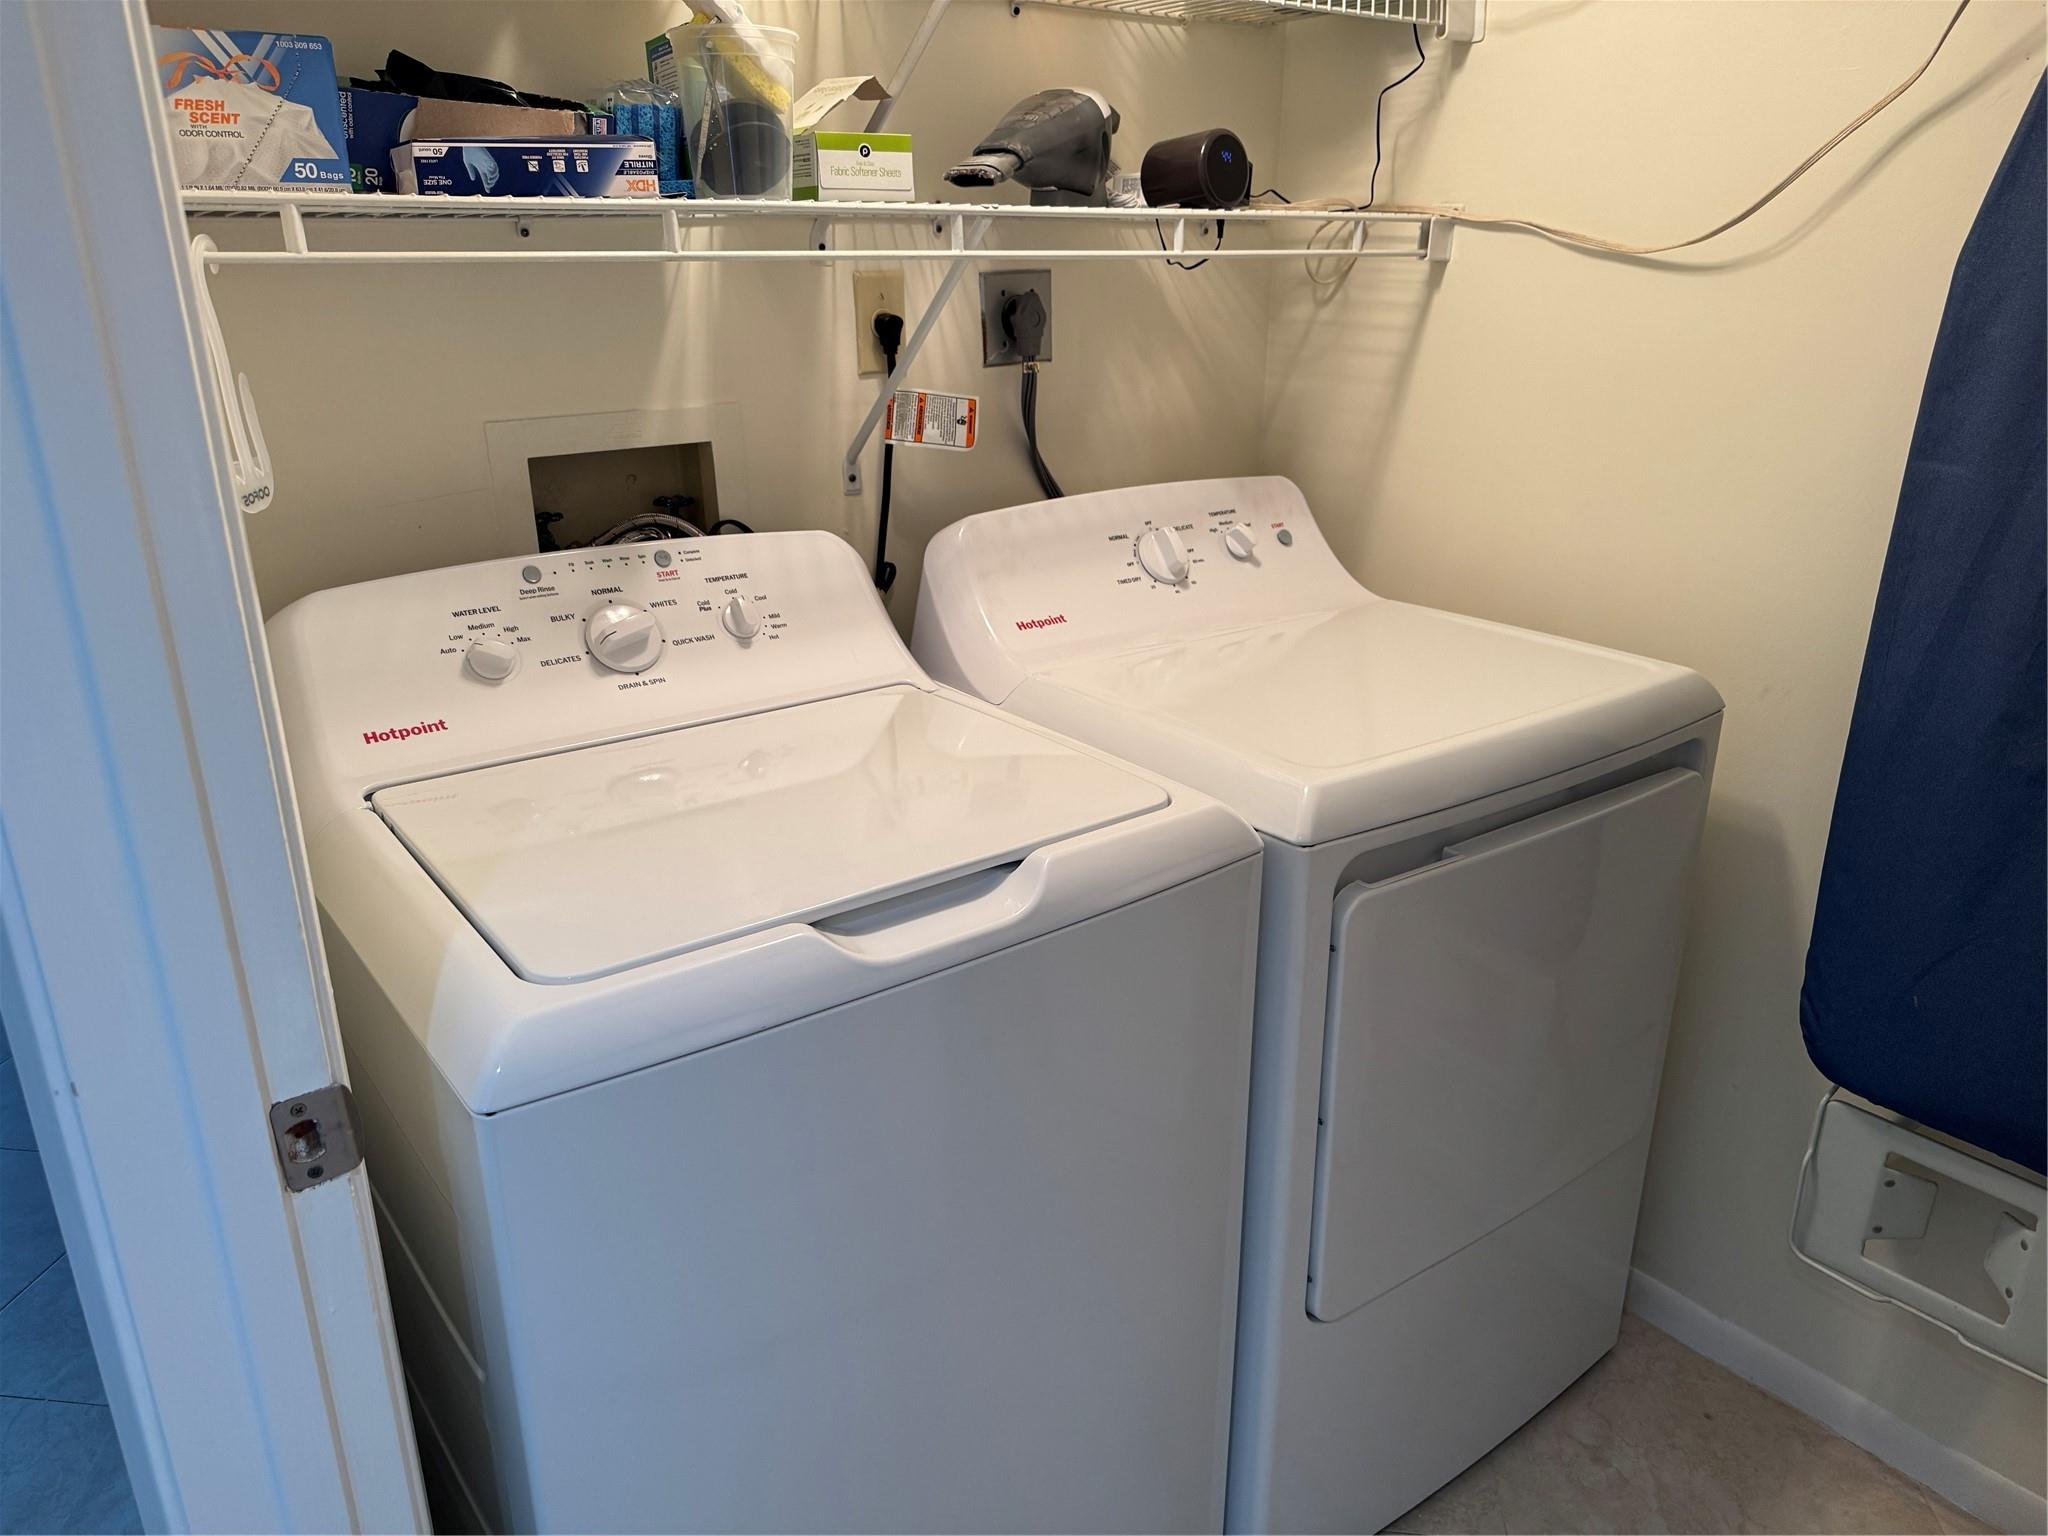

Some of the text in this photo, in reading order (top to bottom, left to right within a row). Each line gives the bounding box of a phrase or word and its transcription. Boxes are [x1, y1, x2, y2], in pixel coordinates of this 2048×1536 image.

[174, 99, 225, 111] FRESH
[189, 112, 240, 125] SCENT
[179, 129, 244, 139] ODOR CONTROL
[294, 162, 317, 179] 50
[320, 171, 344, 180] Bags
[364, 168, 379, 185] 20
[830, 166, 902, 178] Fabric Softener Sheets
[627, 180, 657, 192] HDX
[656, 570, 679, 578] START
[704, 573, 748, 583] TEMPERATURE
[520, 588, 537, 596] Deep
[591, 586, 623, 596] NORMAL
[650, 599, 678, 609] WHITES
[452, 606, 501, 618] WATER LEVEL
[550, 613, 576, 623] BULKY
[468, 622, 495, 631] Medium
[1016, 614, 1067, 631] Hotpoint
[503, 625, 519, 633] High
[672, 634, 715, 647] QUICK WASH
[440, 647, 457, 655] Auto
[540, 655, 581, 668] DELICATES
[618, 681, 641, 691] DRAIN
[649, 677, 666, 686] SPIN
[363, 719, 449, 744] Hotpoint
